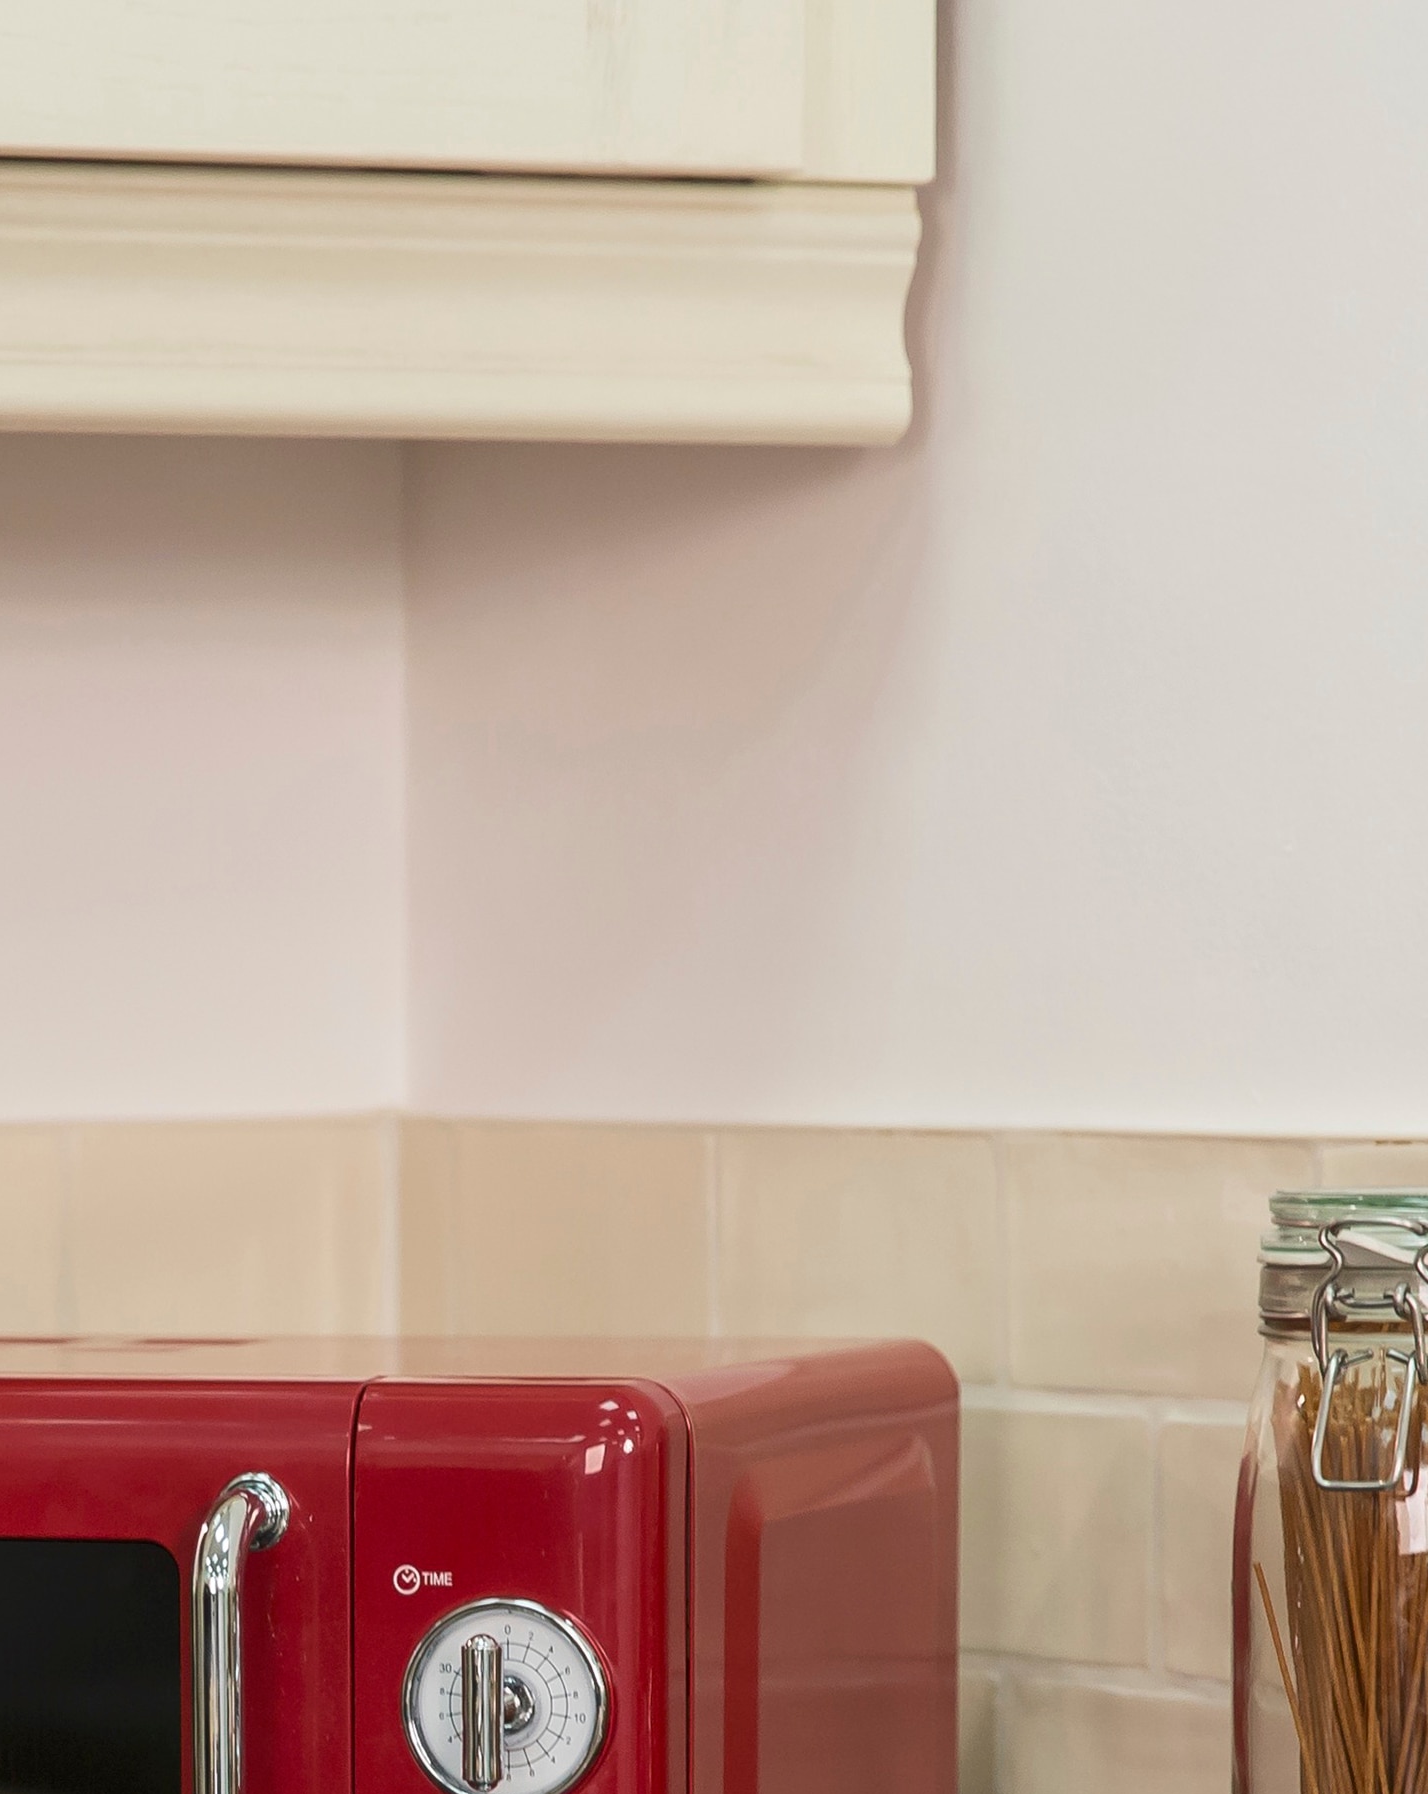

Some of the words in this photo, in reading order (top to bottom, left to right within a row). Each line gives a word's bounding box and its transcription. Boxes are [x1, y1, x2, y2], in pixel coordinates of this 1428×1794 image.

[422, 1571, 453, 1586] TIME
[504, 1624, 512, 1635] 0
[439, 1663, 453, 1674] 30
[574, 1712, 587, 1724] 10
